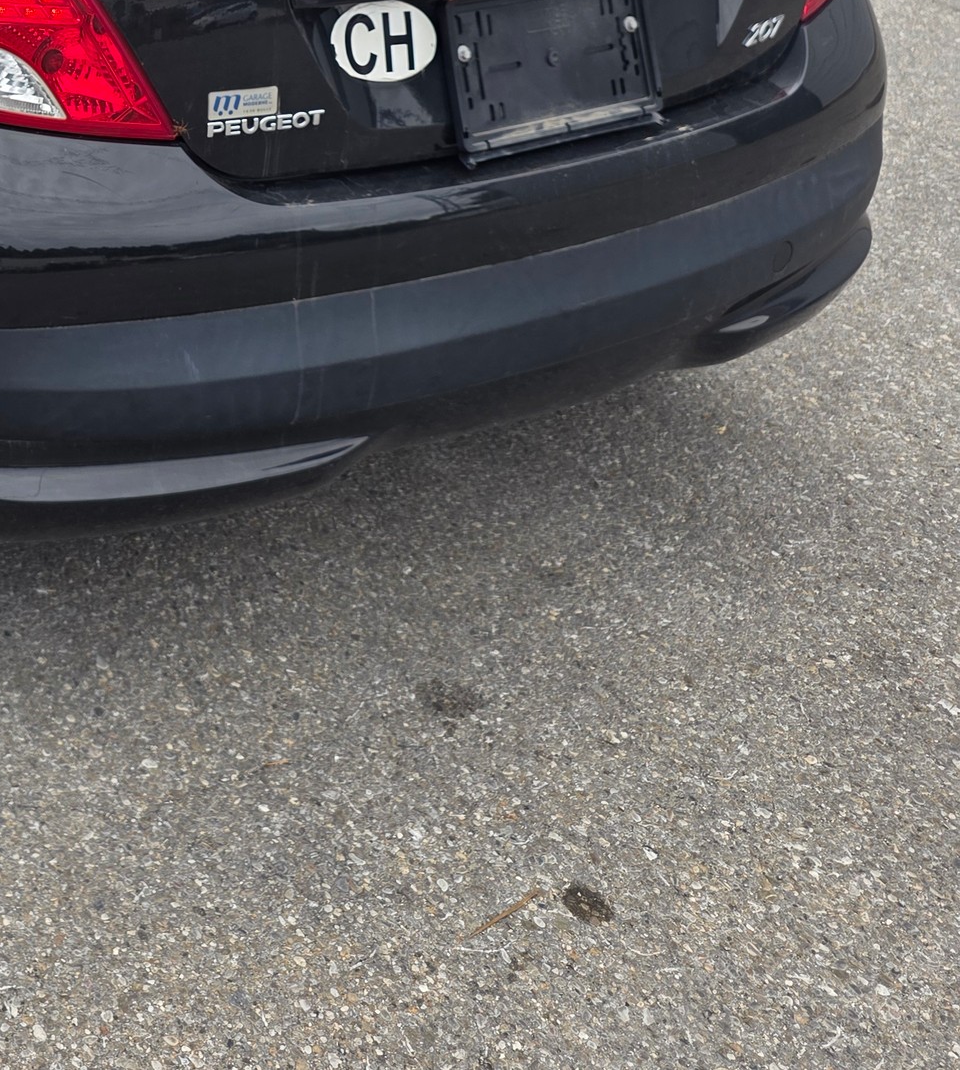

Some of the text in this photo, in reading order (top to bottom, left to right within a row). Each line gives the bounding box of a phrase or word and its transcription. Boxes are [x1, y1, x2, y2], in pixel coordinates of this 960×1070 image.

[344, 10, 415, 75] CH
[743, 13, 785, 48] 207
[242, 92, 272, 101] GARAGE
[206, 109, 326, 138] PEUGEOT
